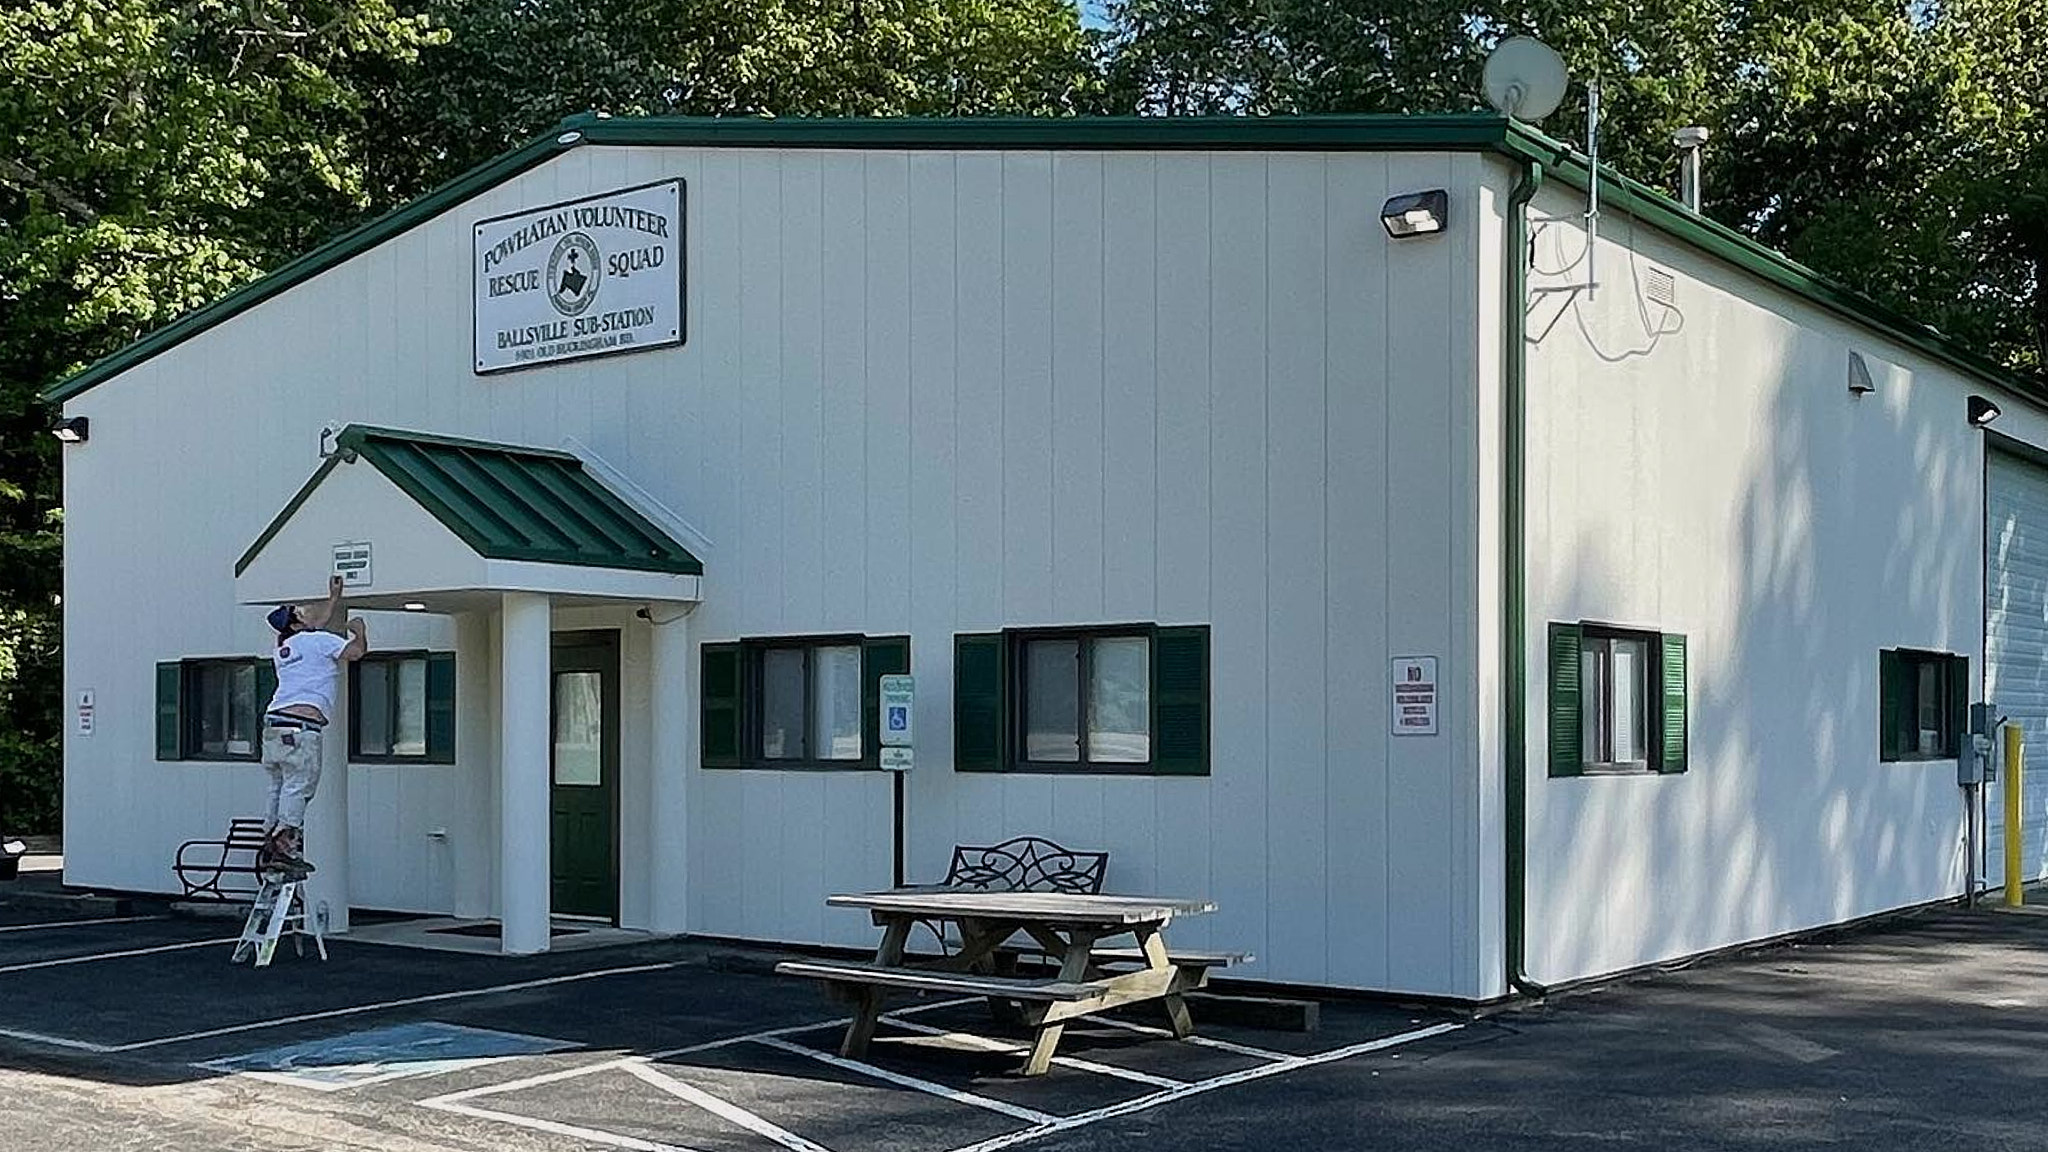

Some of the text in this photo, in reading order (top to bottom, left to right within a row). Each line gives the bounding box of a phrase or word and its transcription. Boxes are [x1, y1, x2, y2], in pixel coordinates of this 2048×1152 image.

[484, 211, 569, 273] POWHATAN
[573, 206, 669, 238] VOLUNTEER
[489, 269, 539, 297] RESCUE
[608, 245, 664, 278] SQUAD
[497, 306, 655, 349] BALLSVILLE SUB-STATION
